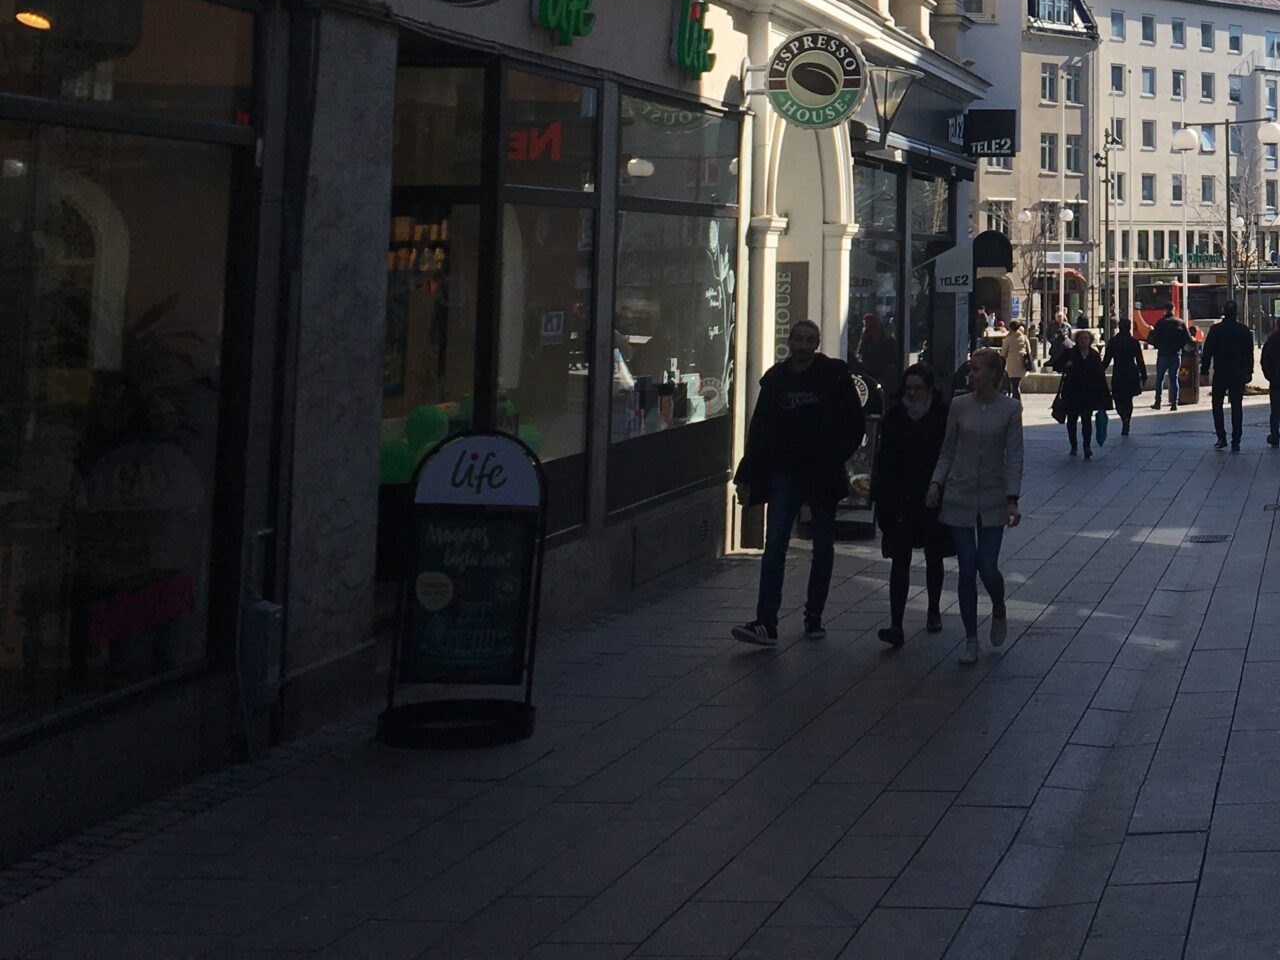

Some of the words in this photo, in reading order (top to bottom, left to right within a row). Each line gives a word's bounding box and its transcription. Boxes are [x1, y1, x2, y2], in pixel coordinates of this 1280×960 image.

[773, 35, 857, 72] ESPRESSO
[781, 99, 847, 123] HOUSE
[970, 138, 1012, 154] TELE2
[939, 274, 969, 286] TELE2
[776, 271, 792, 337] HOUSE
